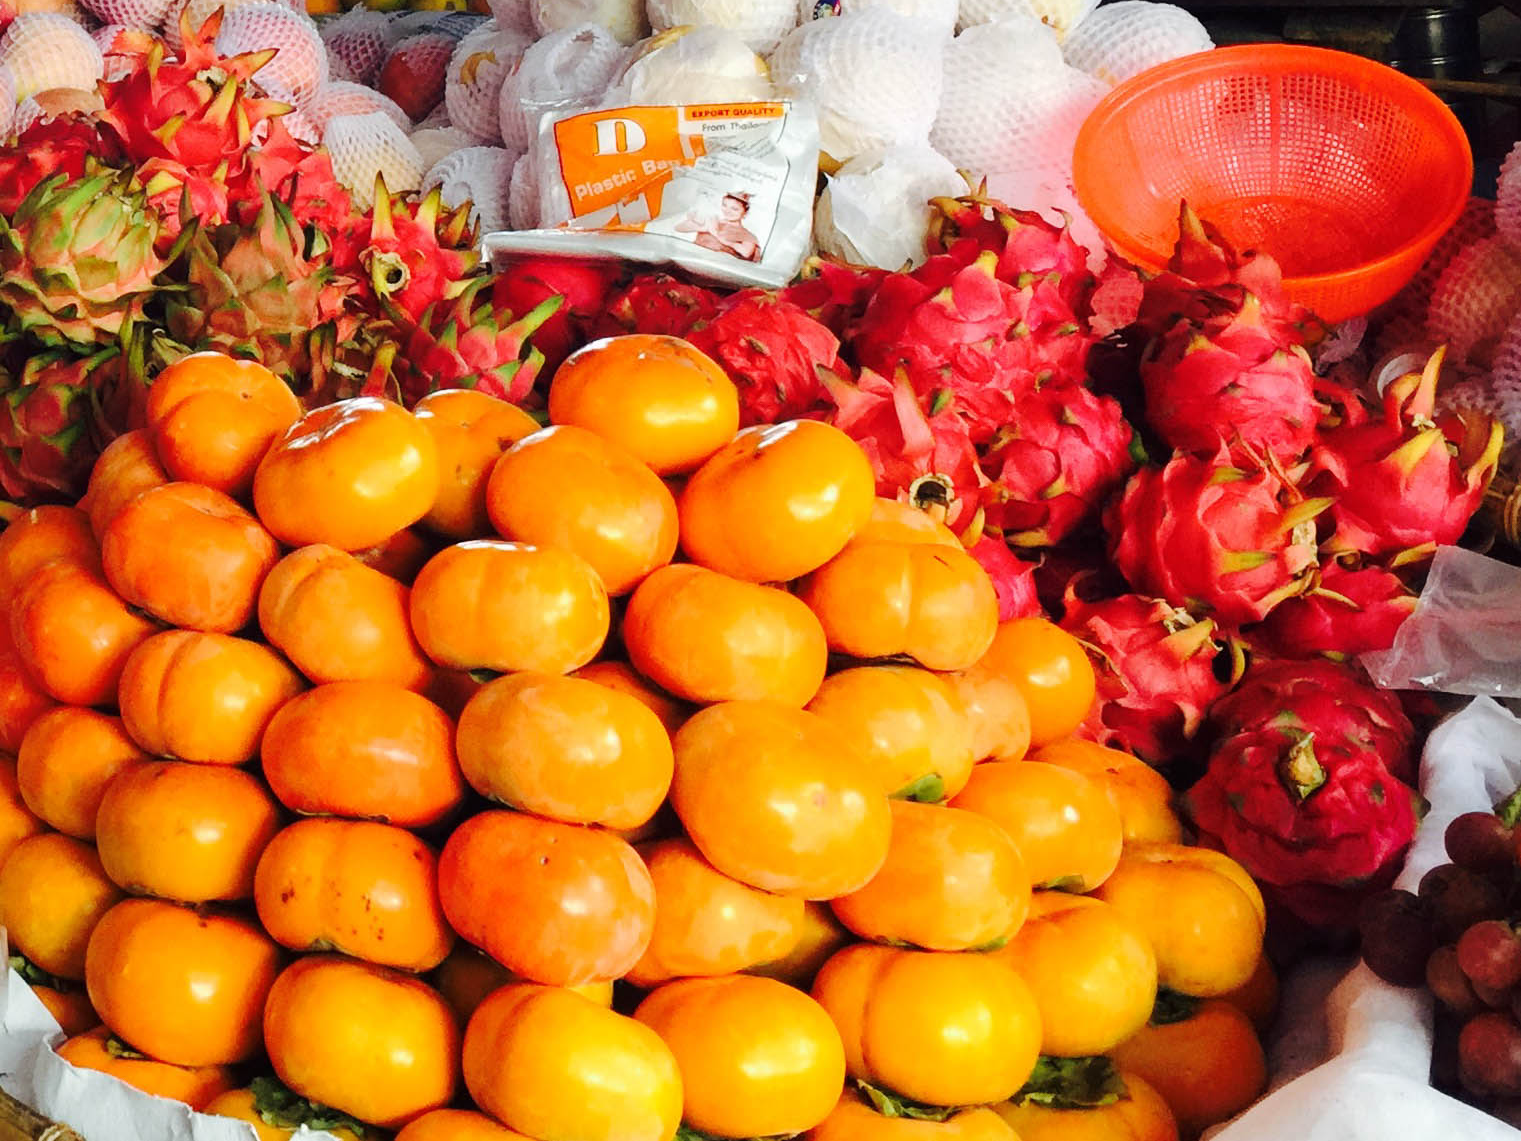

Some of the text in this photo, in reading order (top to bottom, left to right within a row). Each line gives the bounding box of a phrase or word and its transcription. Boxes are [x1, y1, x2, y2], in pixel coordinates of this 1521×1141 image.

[691, 107, 775, 118] EXPORT QUALITY
[701, 122, 726, 132] From
[574, 169, 637, 201] Plastic
